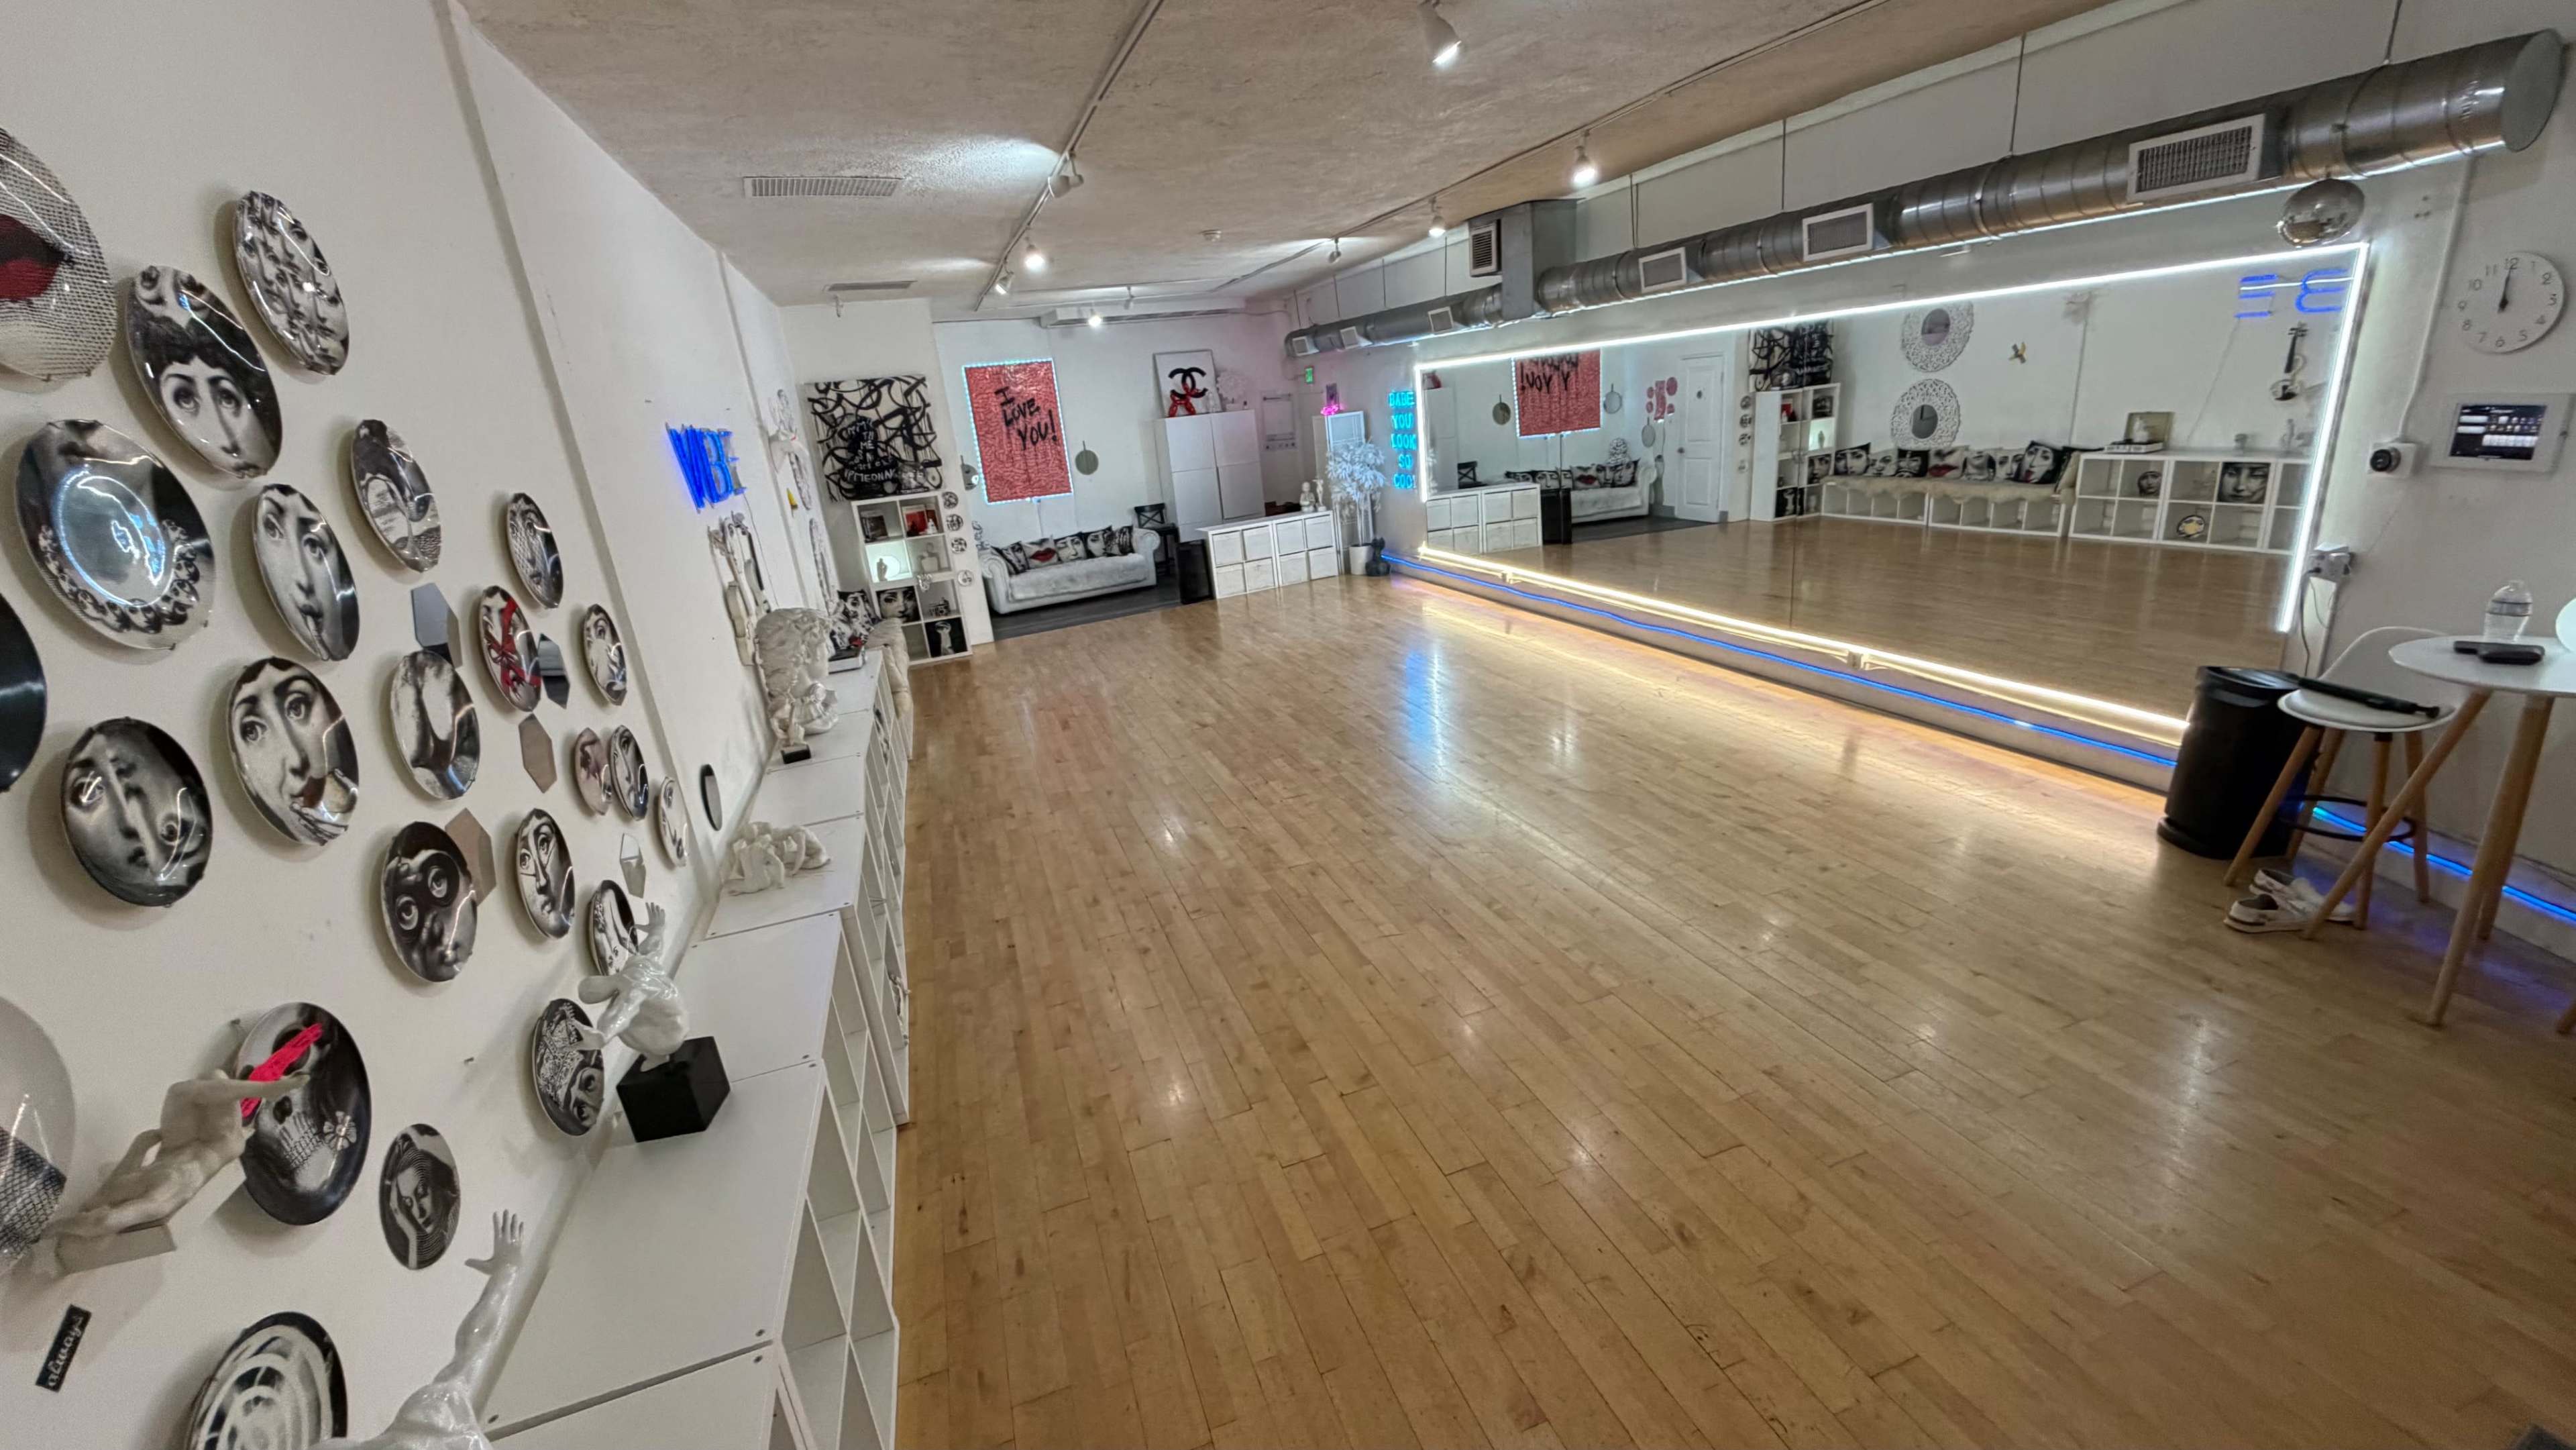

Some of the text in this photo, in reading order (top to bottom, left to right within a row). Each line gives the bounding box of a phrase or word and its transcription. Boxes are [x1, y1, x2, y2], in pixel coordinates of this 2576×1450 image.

[2485, 264, 2497, 276] 11
[2504, 257, 2520, 270] 12
[2469, 278, 2482, 291] 10
[2542, 272, 2552, 285] 2
[2458, 301, 2467, 311] 9
[2548, 293, 2557, 306] 3
[2462, 319, 2472, 331] 8
[2535, 315, 2546, 325] 4
[2477, 331, 2487, 344] 7
[2496, 336, 2505, 348] 6
[994, 386, 1015, 406] I
[1389, 391, 1415, 407] BABE
[1003, 398, 1040, 427] LOVE
[1391, 413, 1413, 430] YOU
[1017, 409, 1057, 450] YOU!
[1391, 433, 1417, 450] LOOK
[1398, 453, 1413, 469] SO
